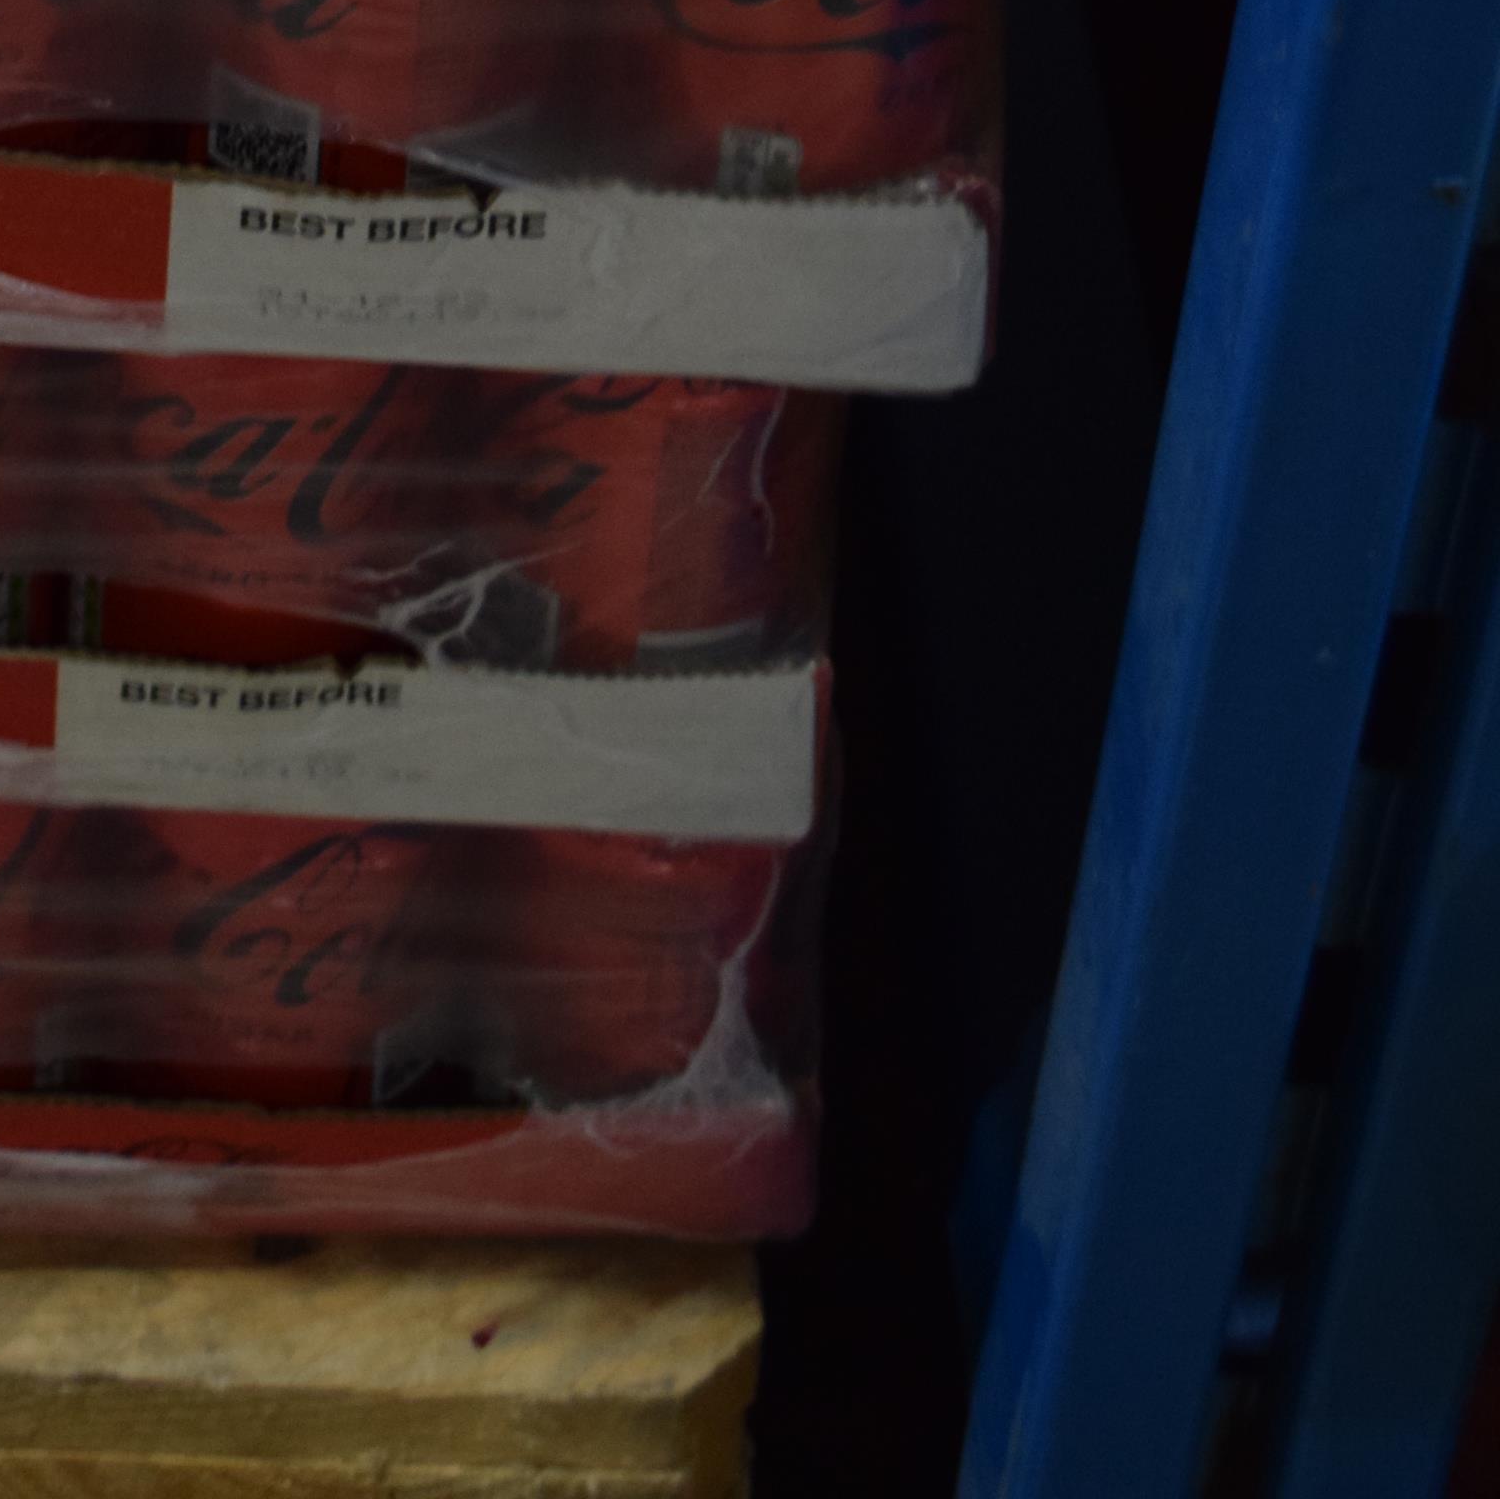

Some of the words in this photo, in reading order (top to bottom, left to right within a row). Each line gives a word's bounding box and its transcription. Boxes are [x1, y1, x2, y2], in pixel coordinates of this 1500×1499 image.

[239, 206, 355, 241] BEST
[367, 210, 547, 244] BEFORE
[120, 679, 227, 710] BEST
[239, 679, 402, 712] BEFORE
